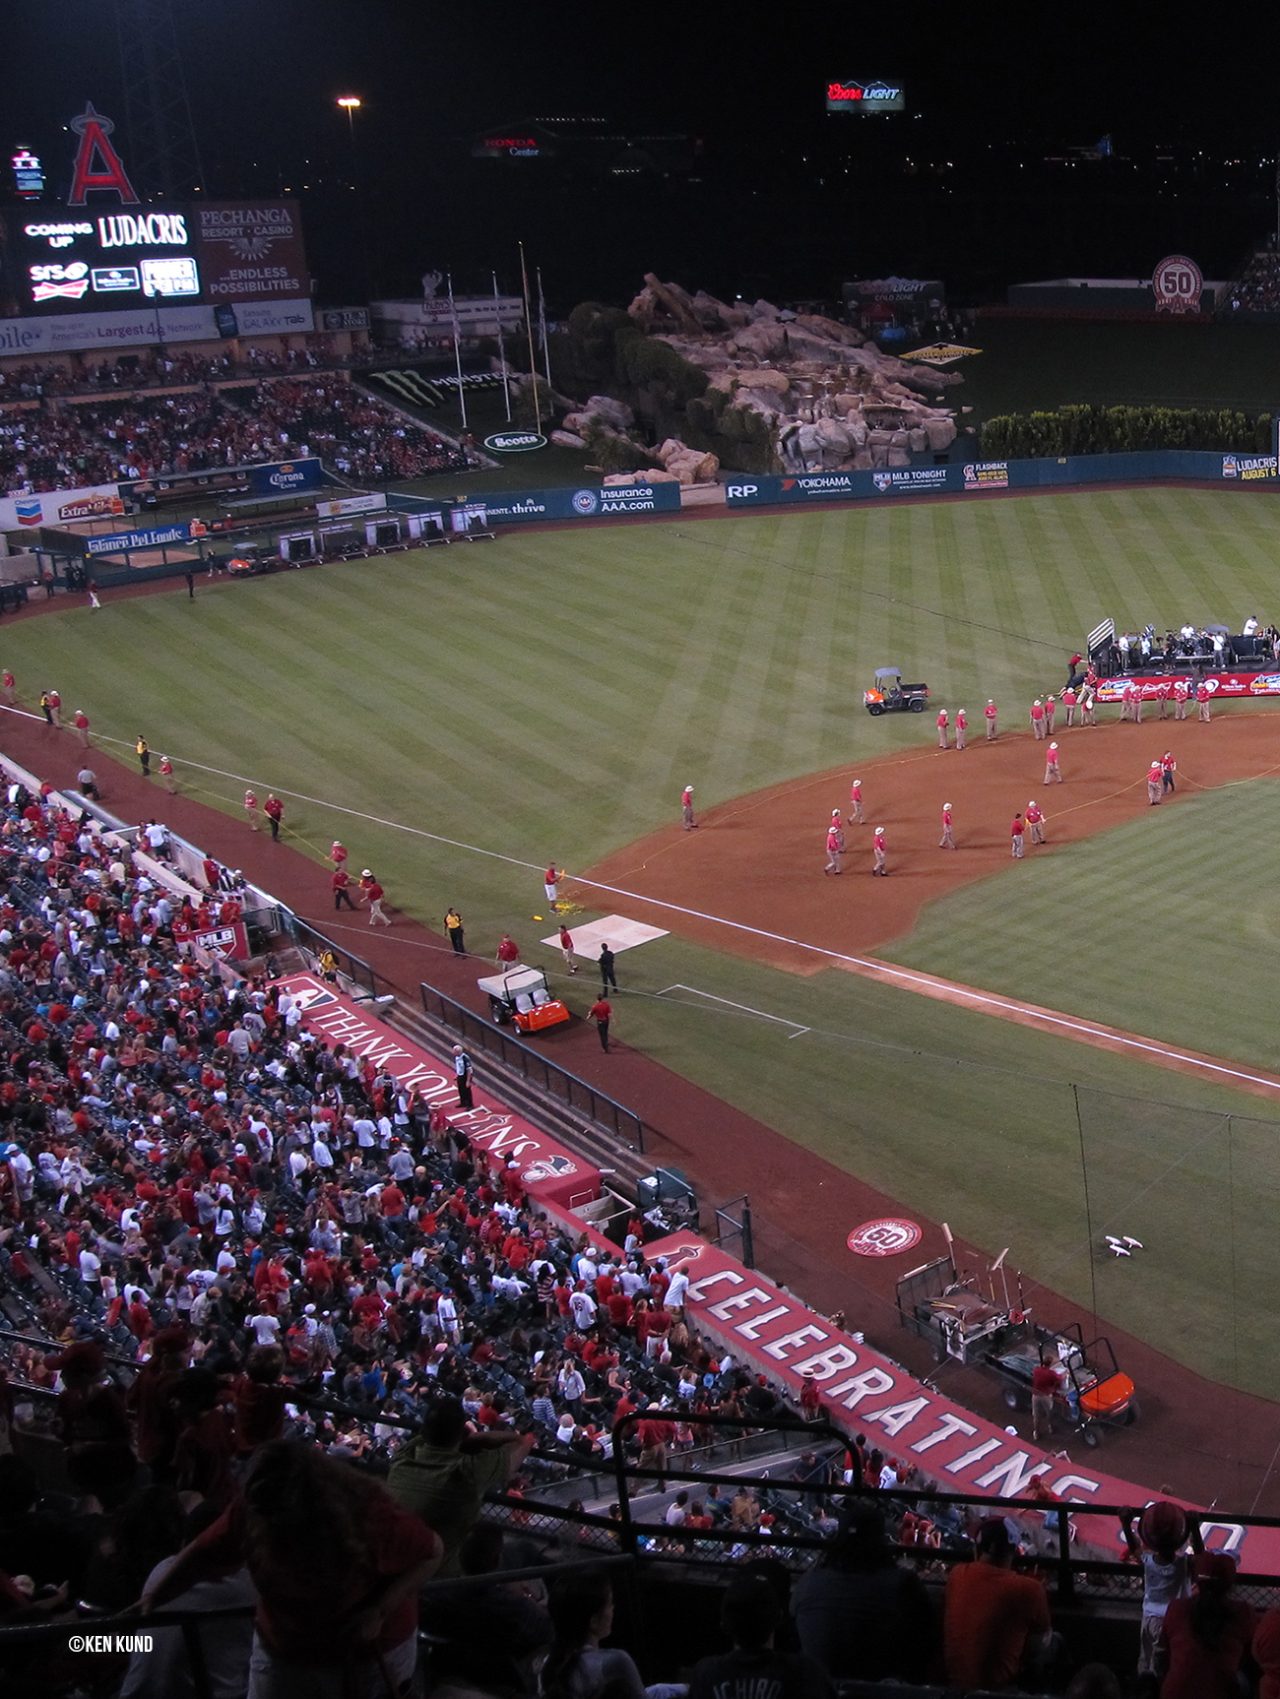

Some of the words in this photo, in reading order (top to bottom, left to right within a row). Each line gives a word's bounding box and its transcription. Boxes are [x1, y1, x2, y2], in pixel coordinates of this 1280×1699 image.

[863, 88, 900, 99] LIGHT
[200, 209, 292, 226] PECHANGA
[25, 222, 93, 236] COMING
[98, 213, 187, 248] LUDACRIS
[202, 227, 243, 238] RESORT
[254, 224, 293, 236] CASINO
[49, 236, 74, 248] UP
[210, 279, 299, 295] POSSIBILITIES
[1164, 271, 1192, 294] 50
[97, 323, 144, 341] Largest
[495, 435, 538, 447] Scotts
[976, 462, 1007, 471] FLASHBACK
[1237, 456, 1277, 472] LUDACRIS
[269, 472, 304, 486] Corona
[892, 472, 910, 480] MLB
[911, 469, 947, 479] TONIGHT
[1241, 469, 1269, 480] AUGUST
[1271, 468, 1277, 477] 6
[798, 477, 851, 488] YOKOHAMA
[600, 488, 653, 499] Insurance
[61, 503, 89, 518] Extra
[512, 502, 546, 514] thrive
[601, 499, 654, 512] AAA.com
[199, 930, 233, 946] MLB
[312, 1006, 413, 1068] THANK
[397, 1063, 460, 1110] YOU
[445, 1104, 540, 1159] FANS
